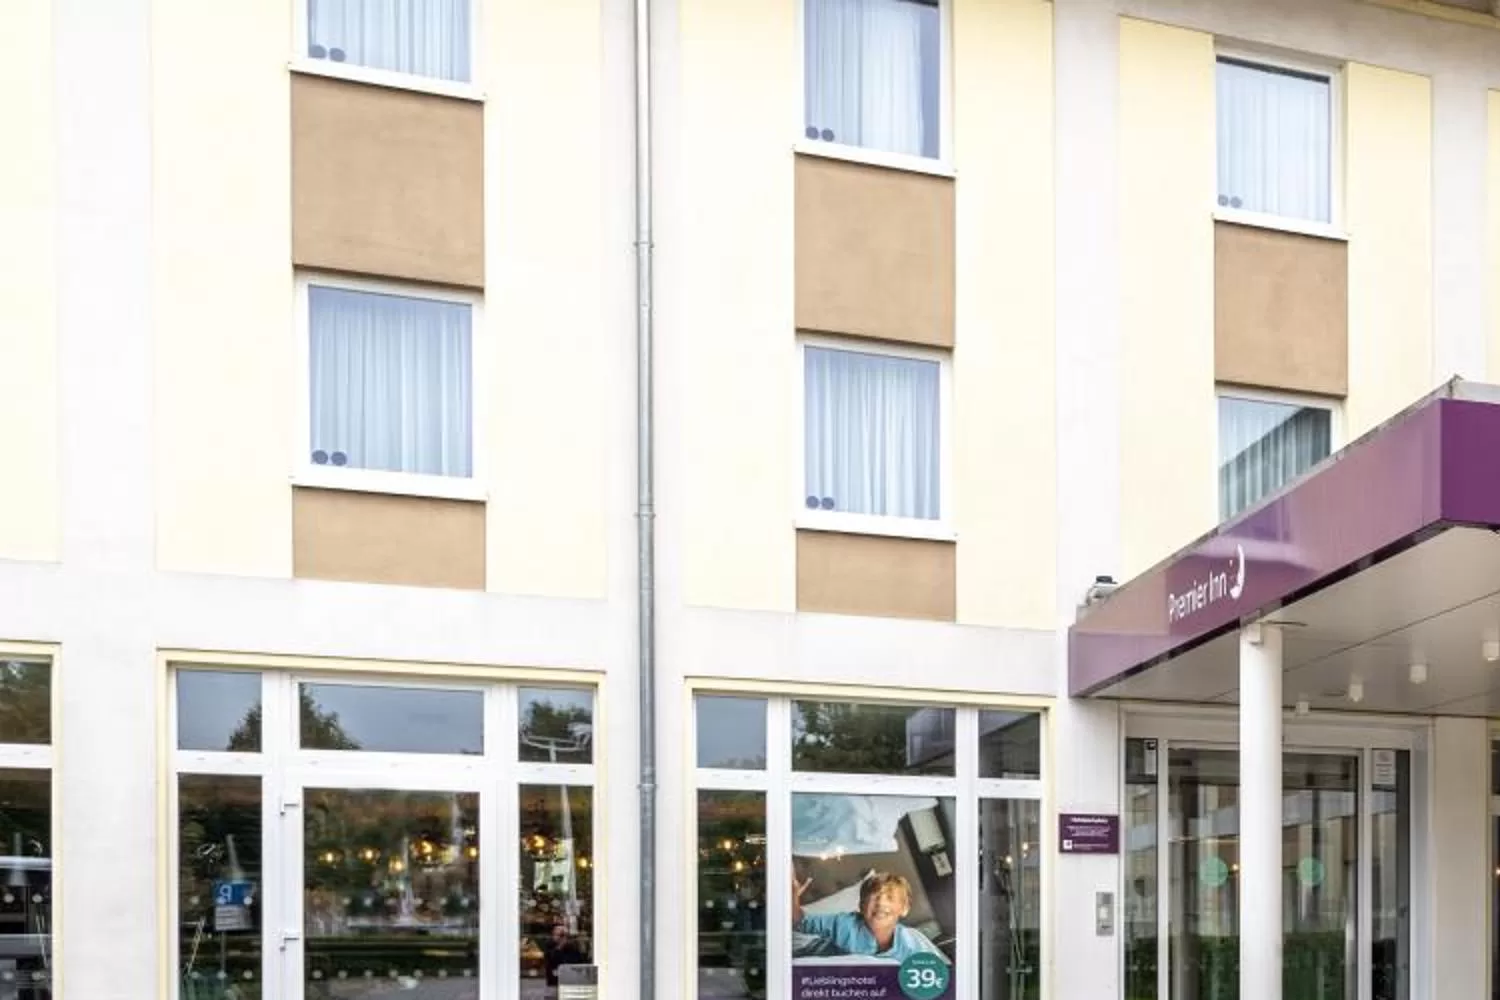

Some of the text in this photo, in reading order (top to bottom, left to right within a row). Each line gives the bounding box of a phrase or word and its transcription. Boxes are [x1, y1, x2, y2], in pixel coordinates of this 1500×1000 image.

[1167, 570, 1227, 623] Premier Inn
[906, 968, 944, 989] 39€
[831, 988, 869, 998] buchen
